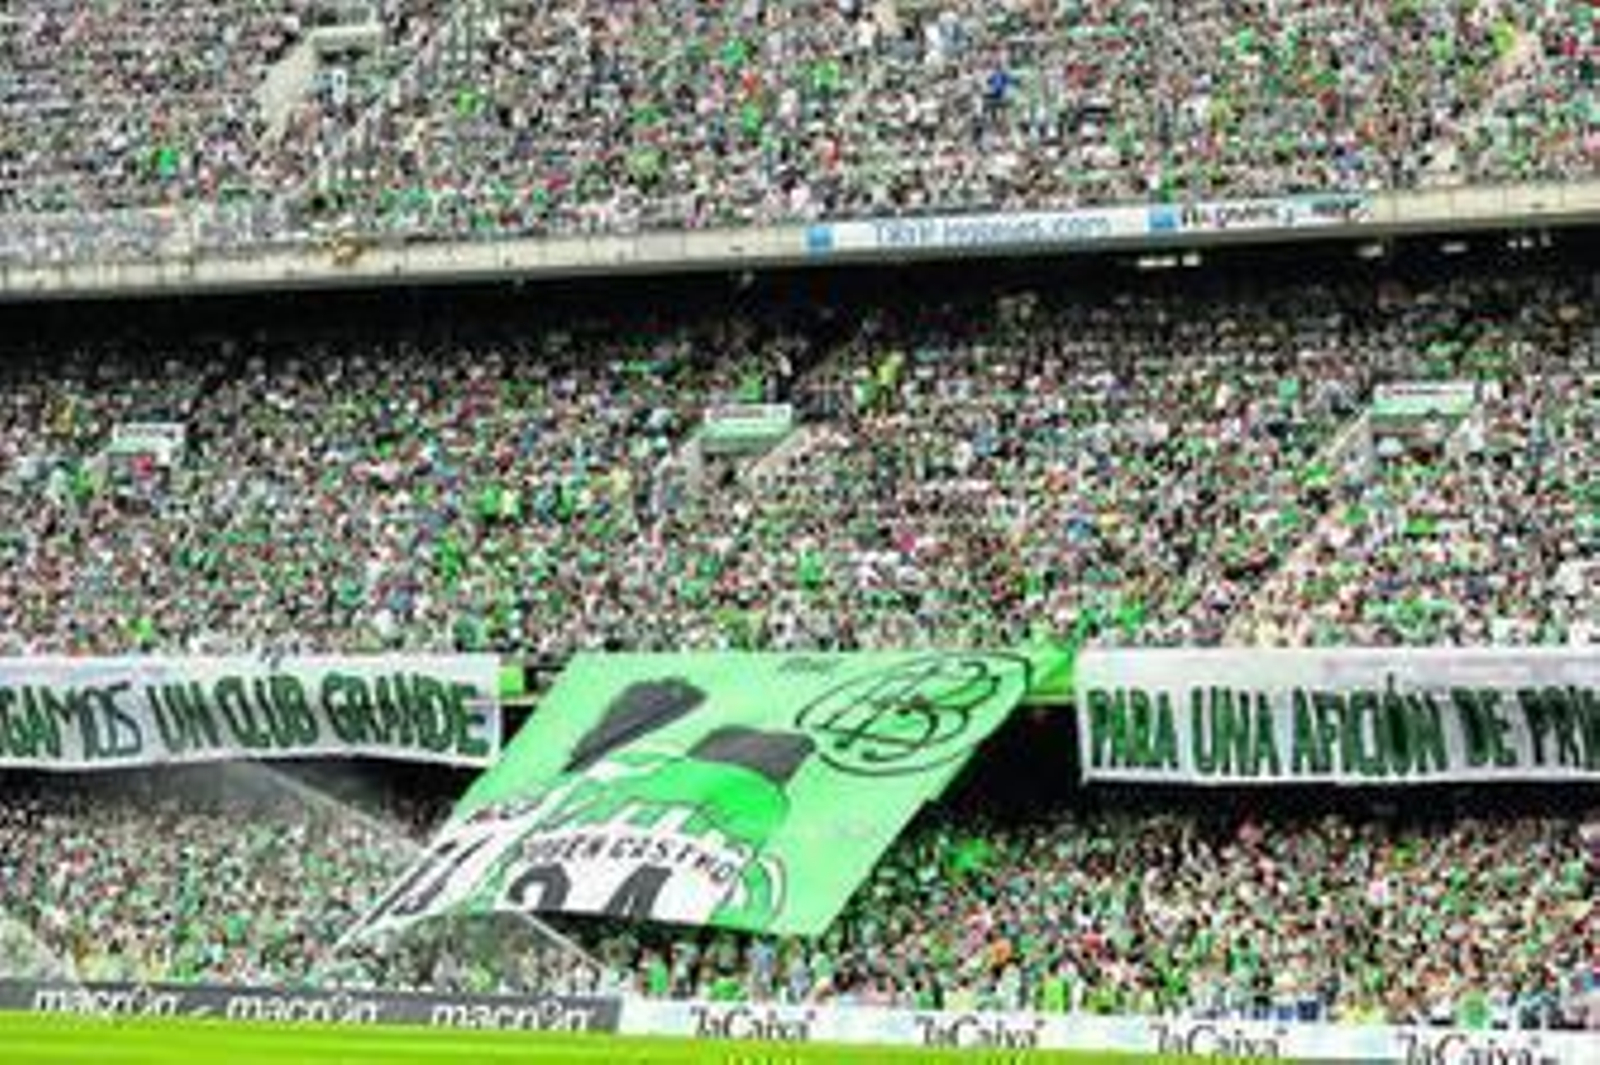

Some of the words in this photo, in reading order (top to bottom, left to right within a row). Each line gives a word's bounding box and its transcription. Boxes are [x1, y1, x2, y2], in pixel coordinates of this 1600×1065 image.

[0, 680, 142, 760] GAMOS
[144, 680, 221, 754] UN
[213, 674, 320, 751] CLUB
[320, 669, 491, 758] GRANDE
[1086, 686, 1180, 769] PARA
[1190, 685, 1282, 777] UNA
[1452, 686, 1518, 768] DE
